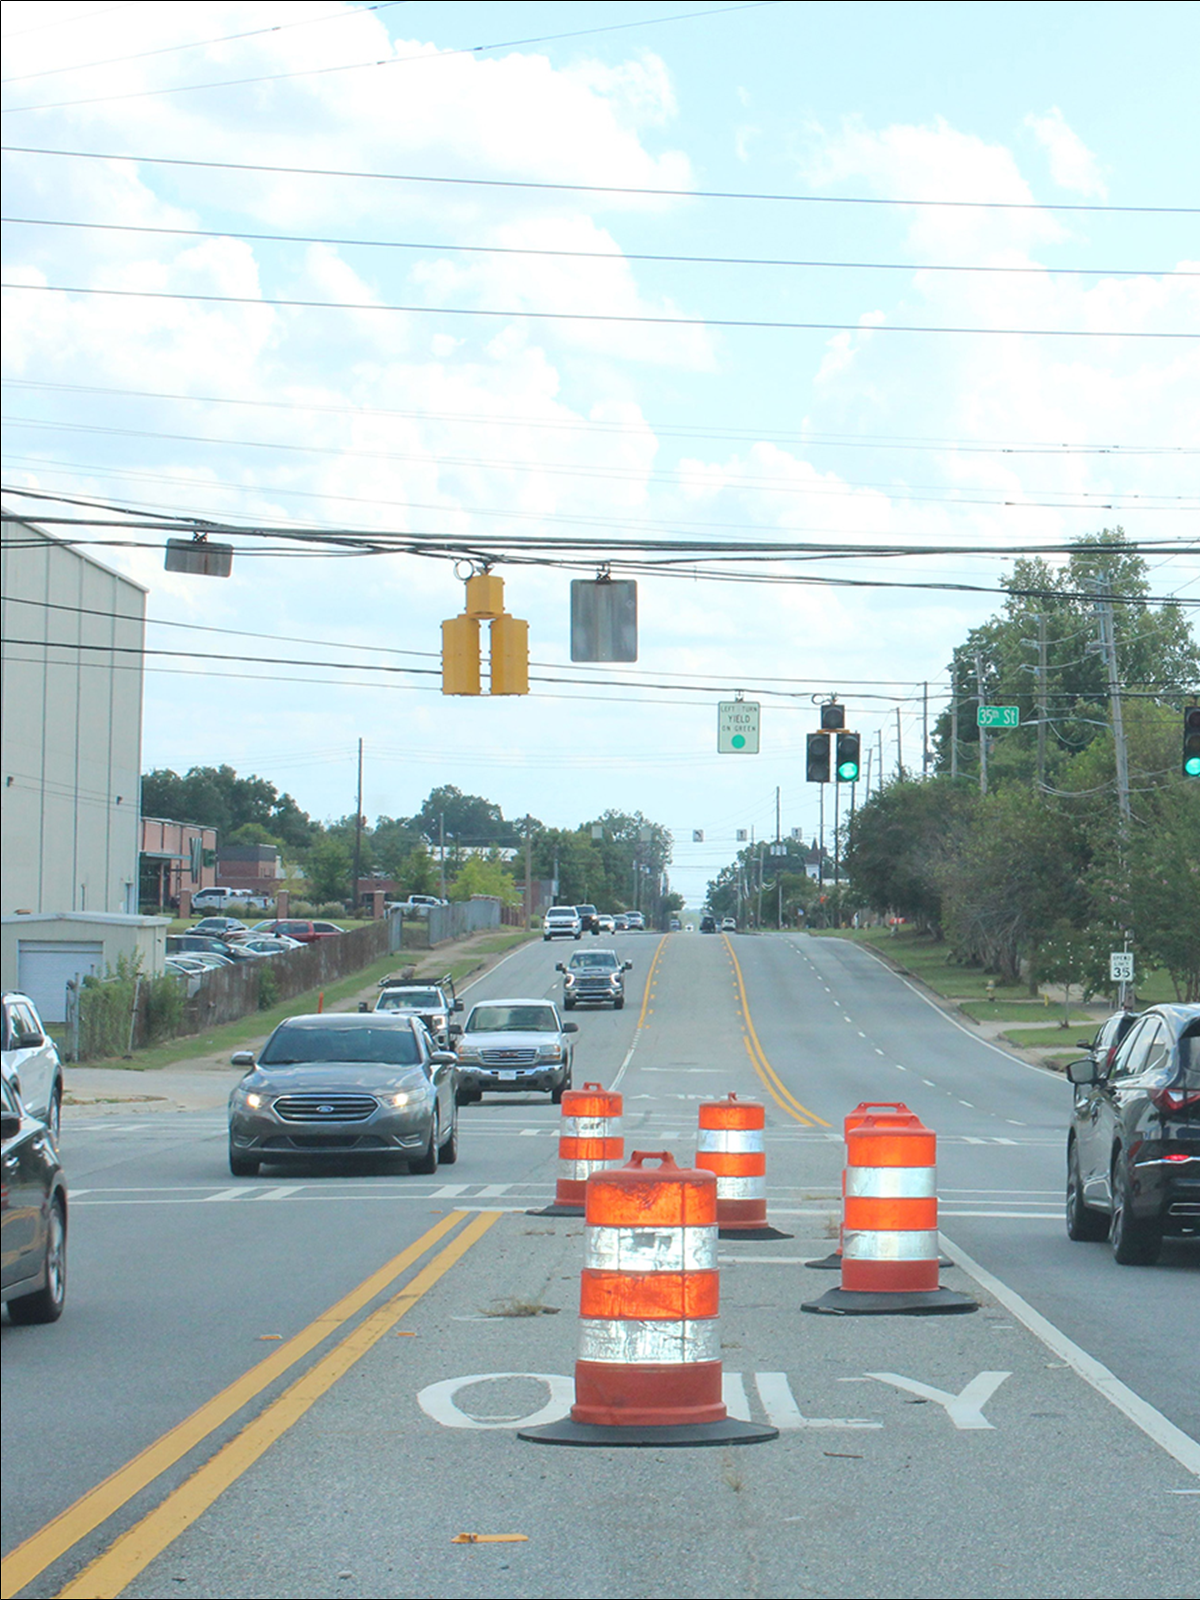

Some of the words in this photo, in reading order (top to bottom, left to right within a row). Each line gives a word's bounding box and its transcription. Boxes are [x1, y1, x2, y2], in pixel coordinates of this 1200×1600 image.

[728, 714, 751, 724] YIELD
[1003, 709, 1015, 724] St
[1113, 967, 1131, 978] 35
